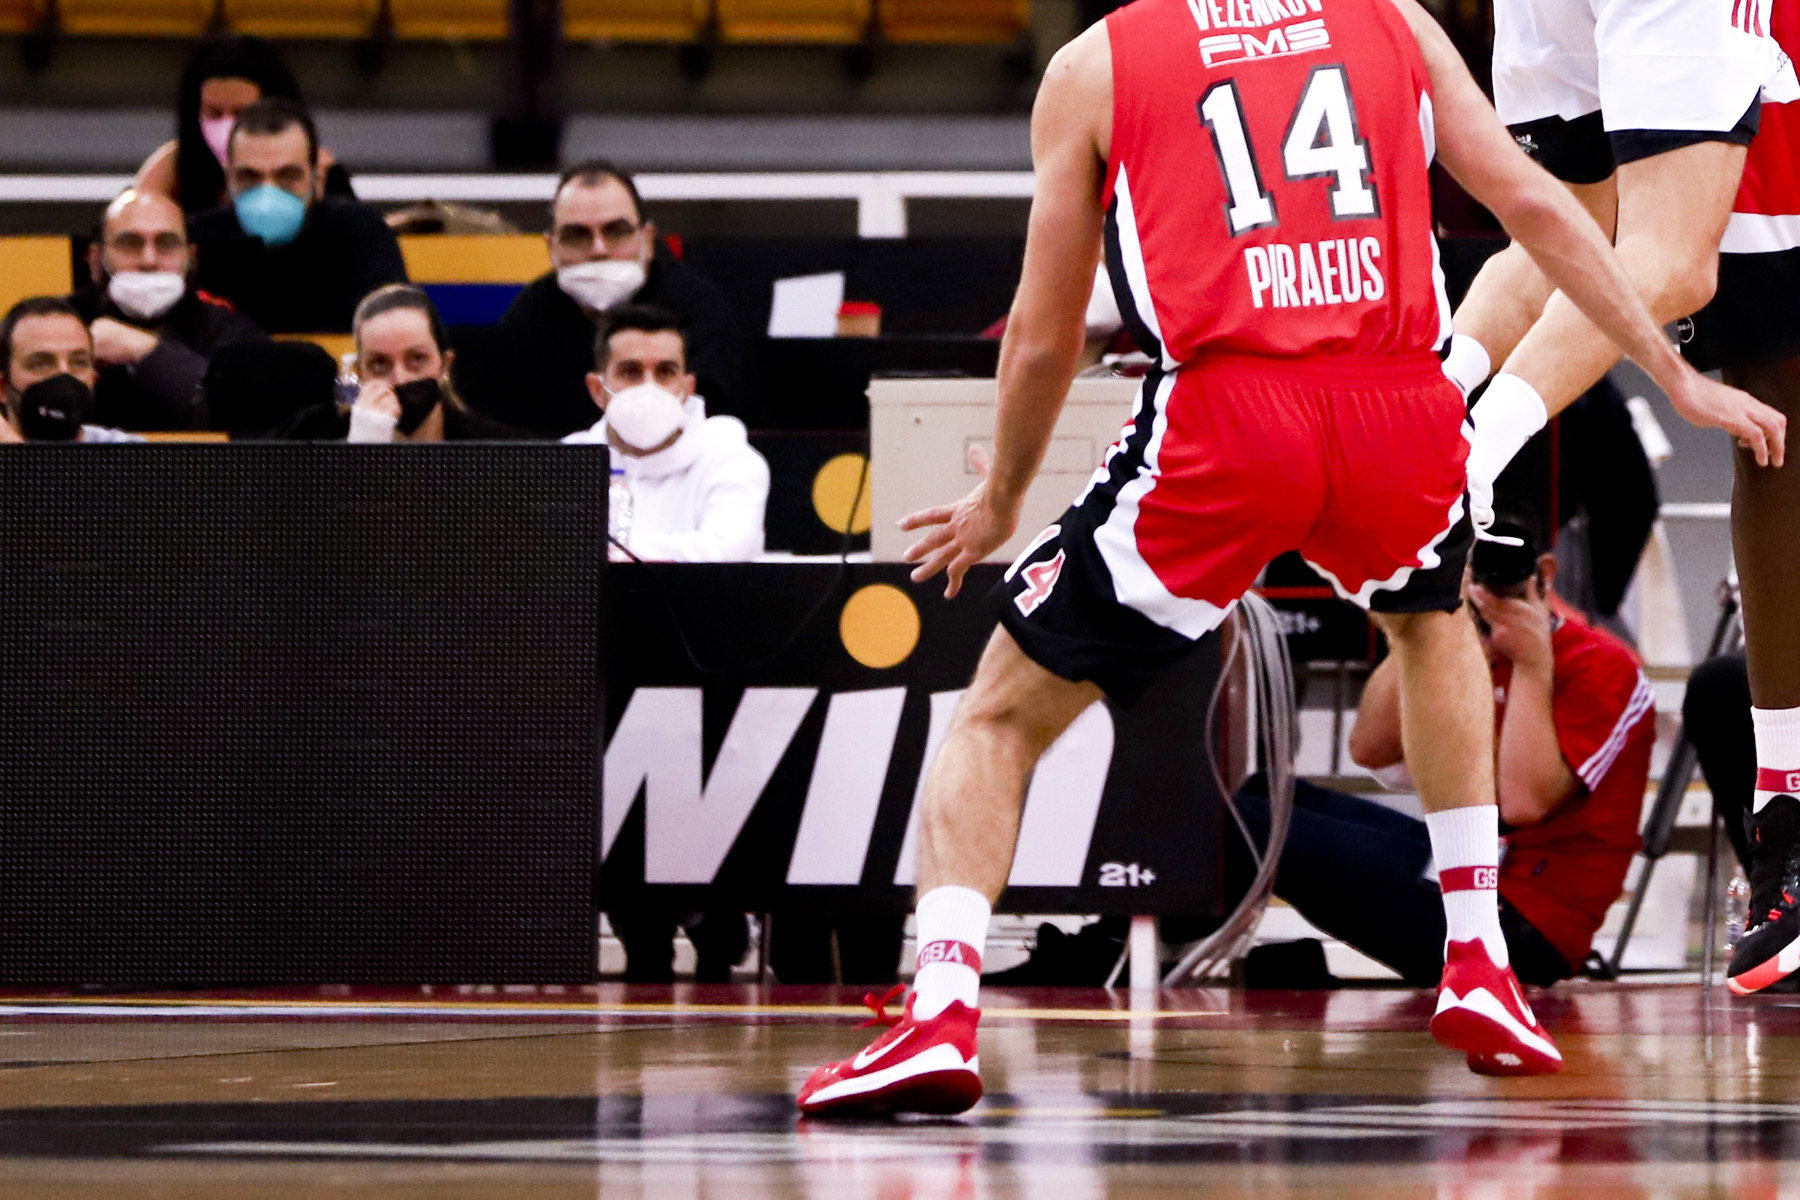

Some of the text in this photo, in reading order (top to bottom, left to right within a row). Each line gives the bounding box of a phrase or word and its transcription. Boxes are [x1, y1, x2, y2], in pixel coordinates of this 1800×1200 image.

[1198, 17, 1332, 69] FMS
[1196, 62, 1382, 238] 14
[1243, 235, 1386, 309] PIRAEUS
[1098, 861, 1157, 888] 21+
[1474, 867, 1498, 889] GS
